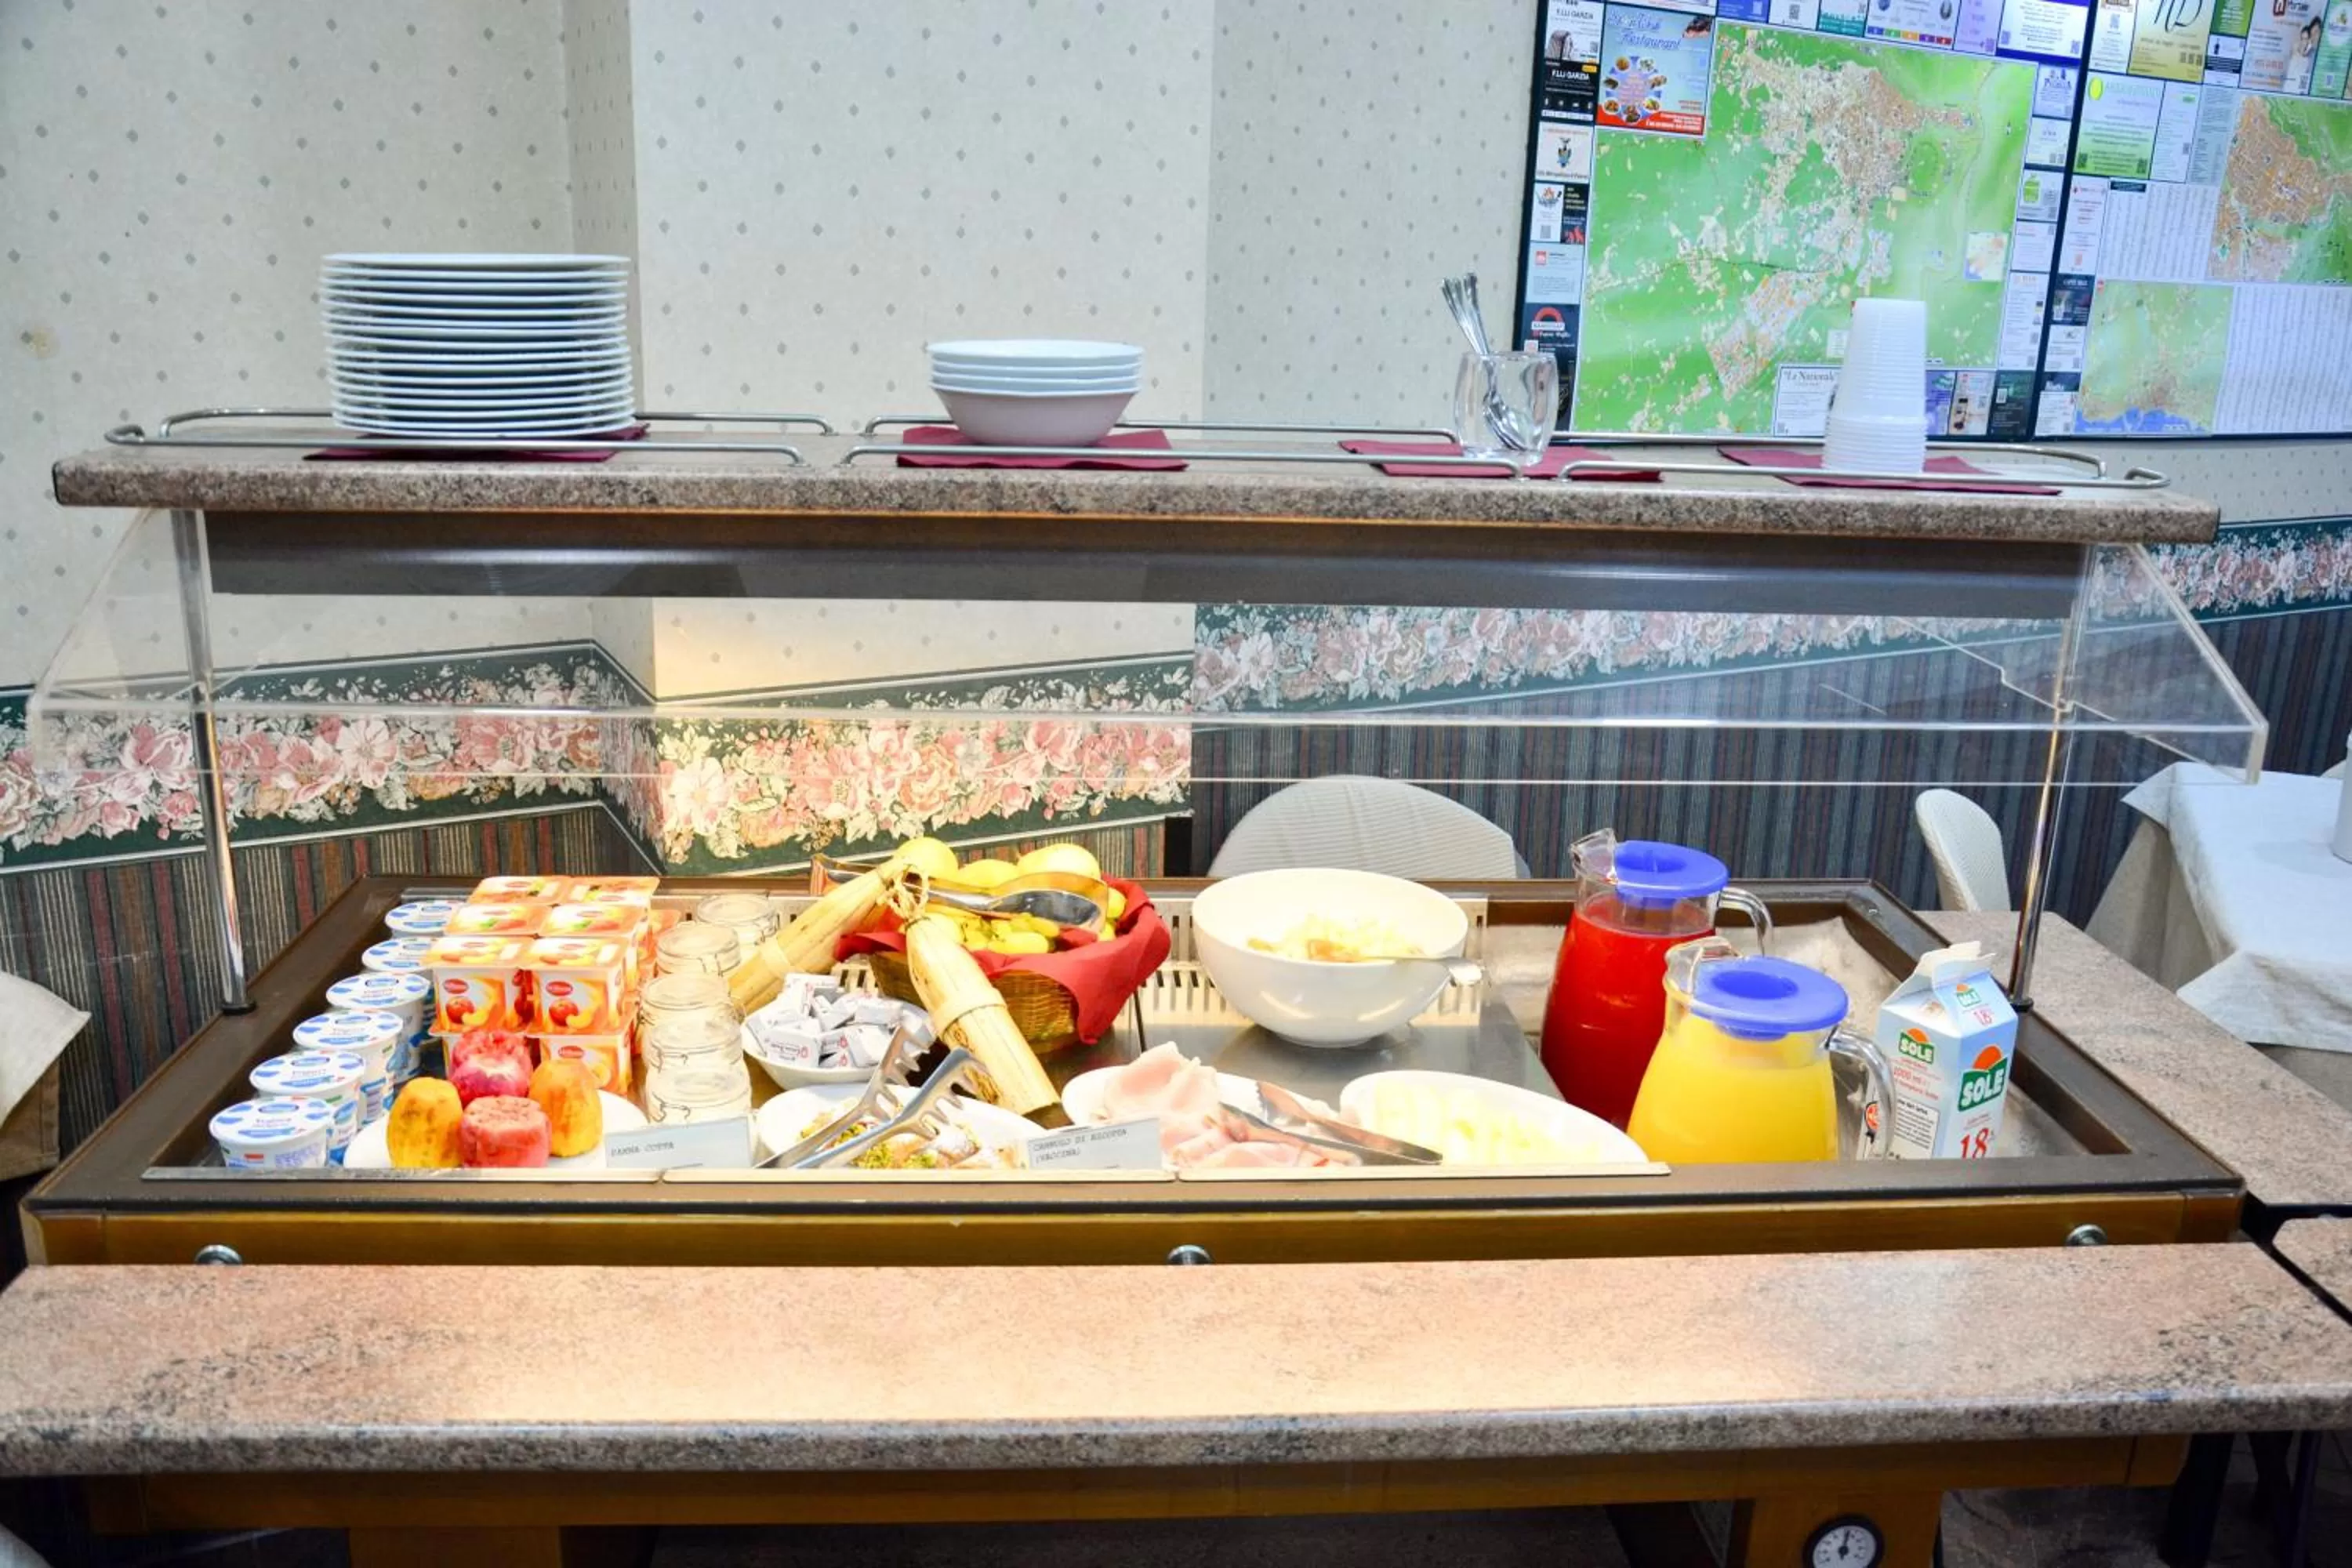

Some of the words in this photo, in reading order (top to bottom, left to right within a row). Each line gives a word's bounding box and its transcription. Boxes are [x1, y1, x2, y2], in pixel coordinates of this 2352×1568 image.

[1900, 1039, 1933, 1061] SOLE
[1961, 1068, 2005, 1108] SOLE
[1960, 1127, 1990, 1160] 18
